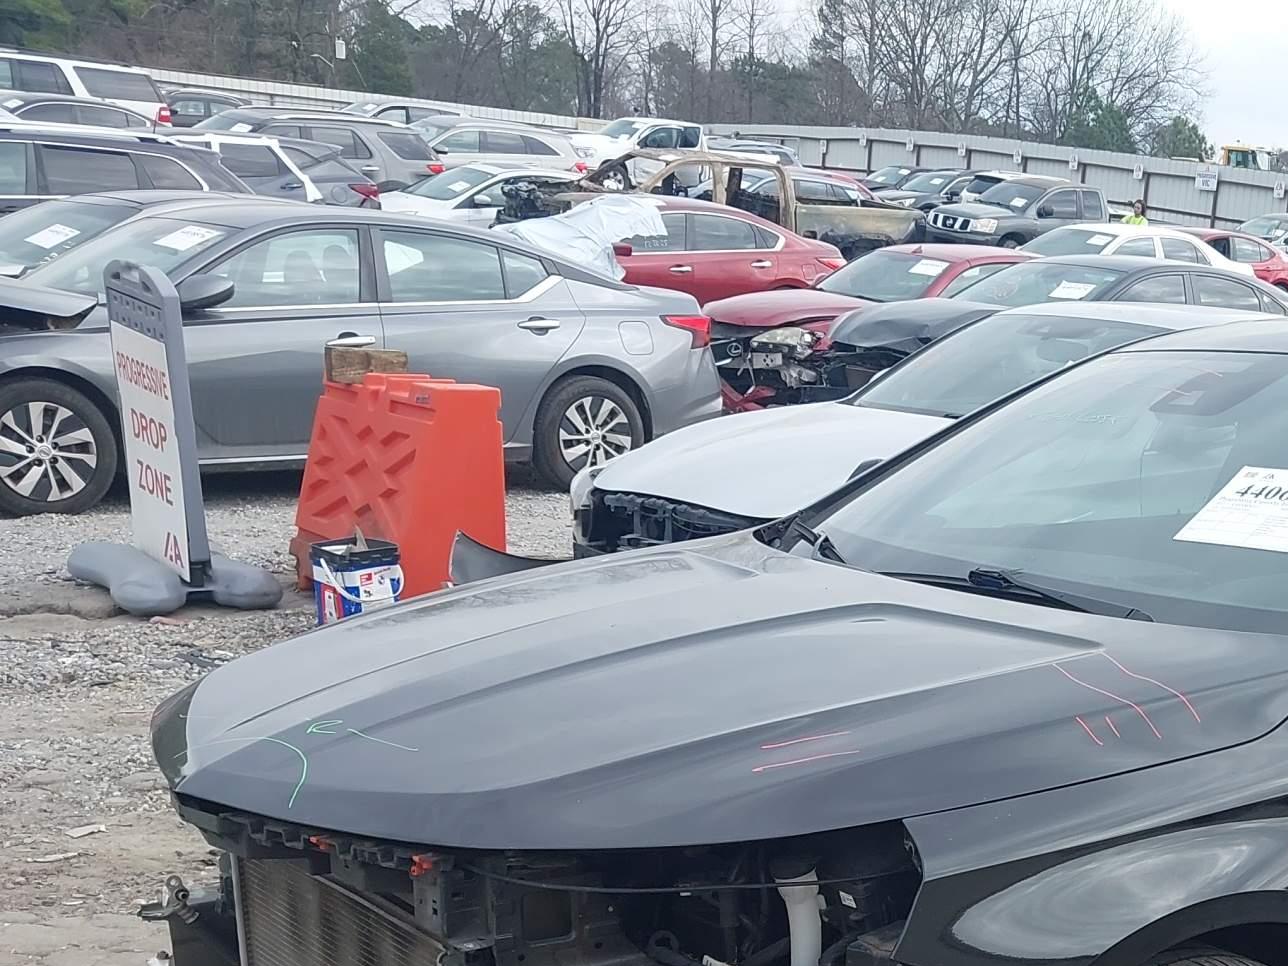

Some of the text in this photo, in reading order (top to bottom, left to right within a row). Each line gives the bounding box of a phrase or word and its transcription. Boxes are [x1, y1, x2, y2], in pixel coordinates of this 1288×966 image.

[116, 351, 169, 401] PROGRESSIVE
[130, 407, 167, 453] DROP
[136, 458, 174, 507] ZONE
